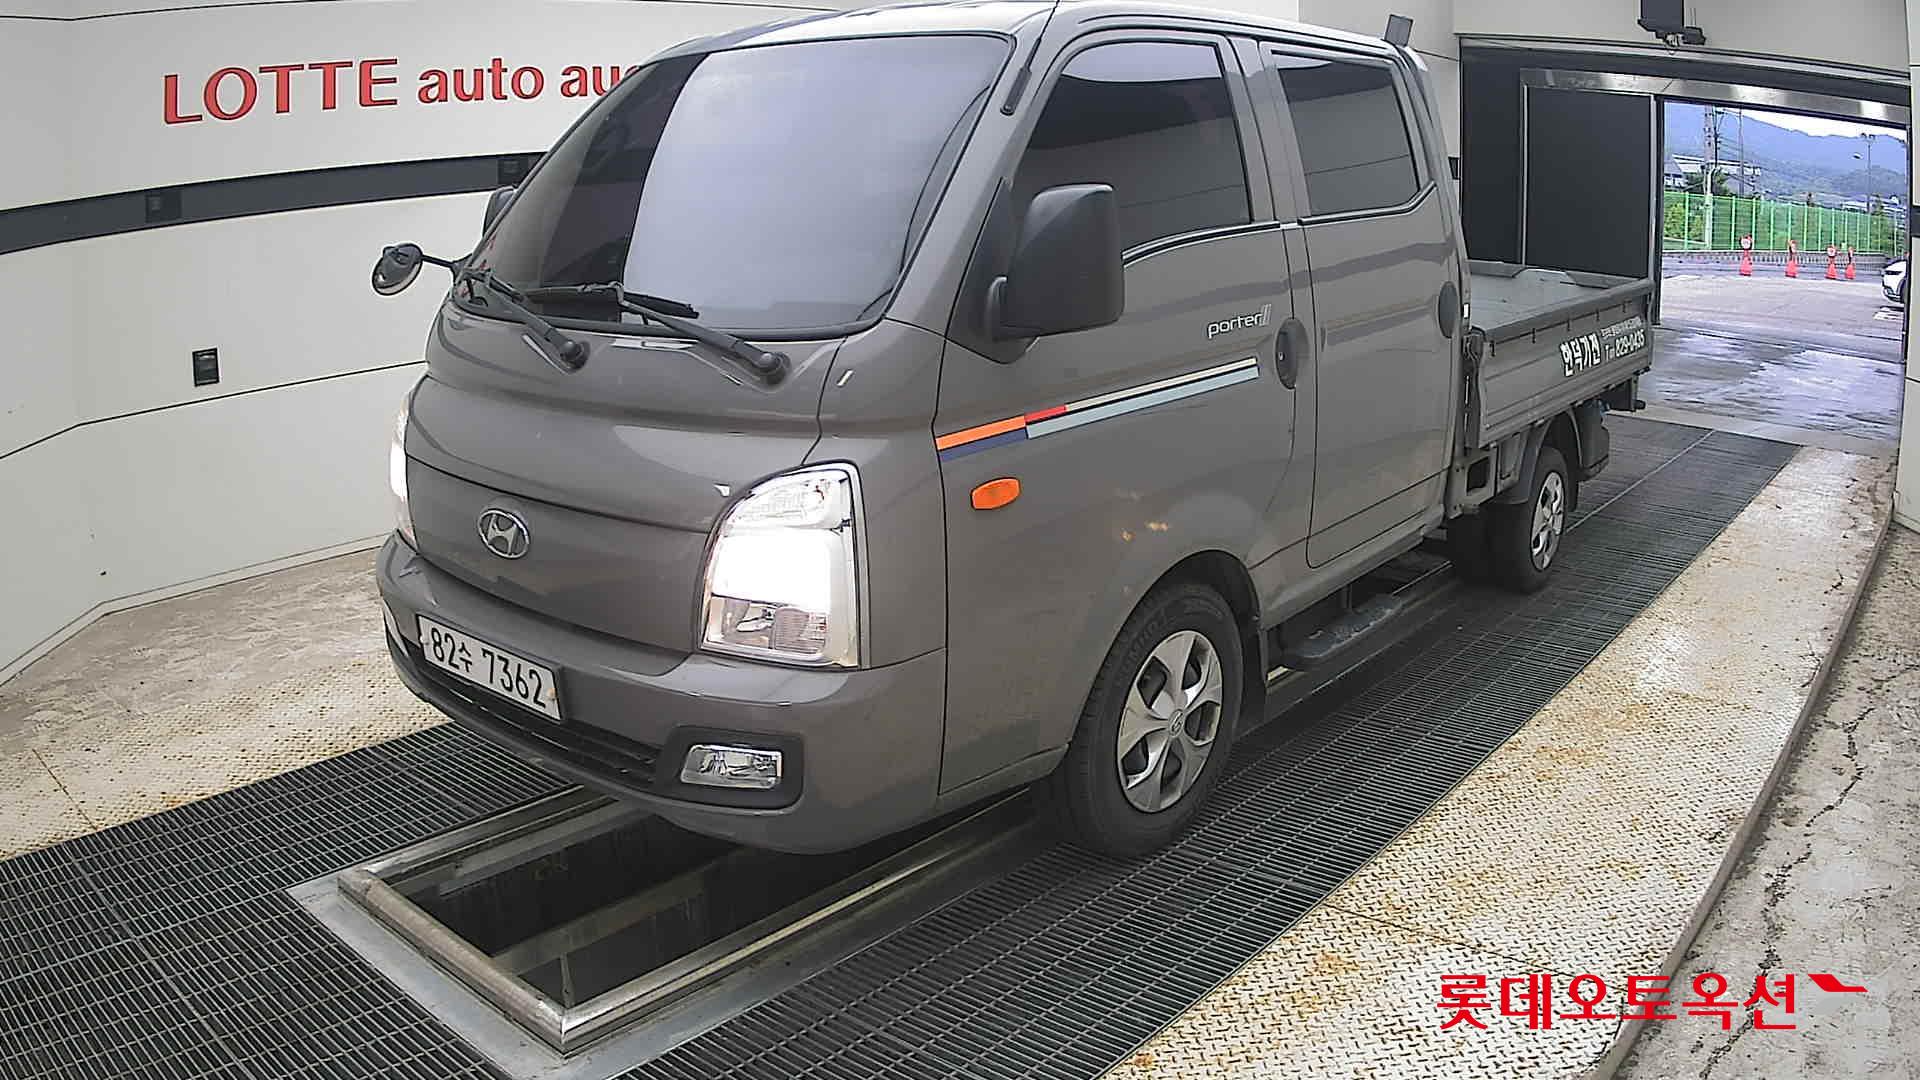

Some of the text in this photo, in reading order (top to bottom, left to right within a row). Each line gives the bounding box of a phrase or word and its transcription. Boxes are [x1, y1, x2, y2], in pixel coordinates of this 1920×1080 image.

[164, 57, 639, 124] LOTTE auto au
[431, 627, 546, 709] 82수 7362
